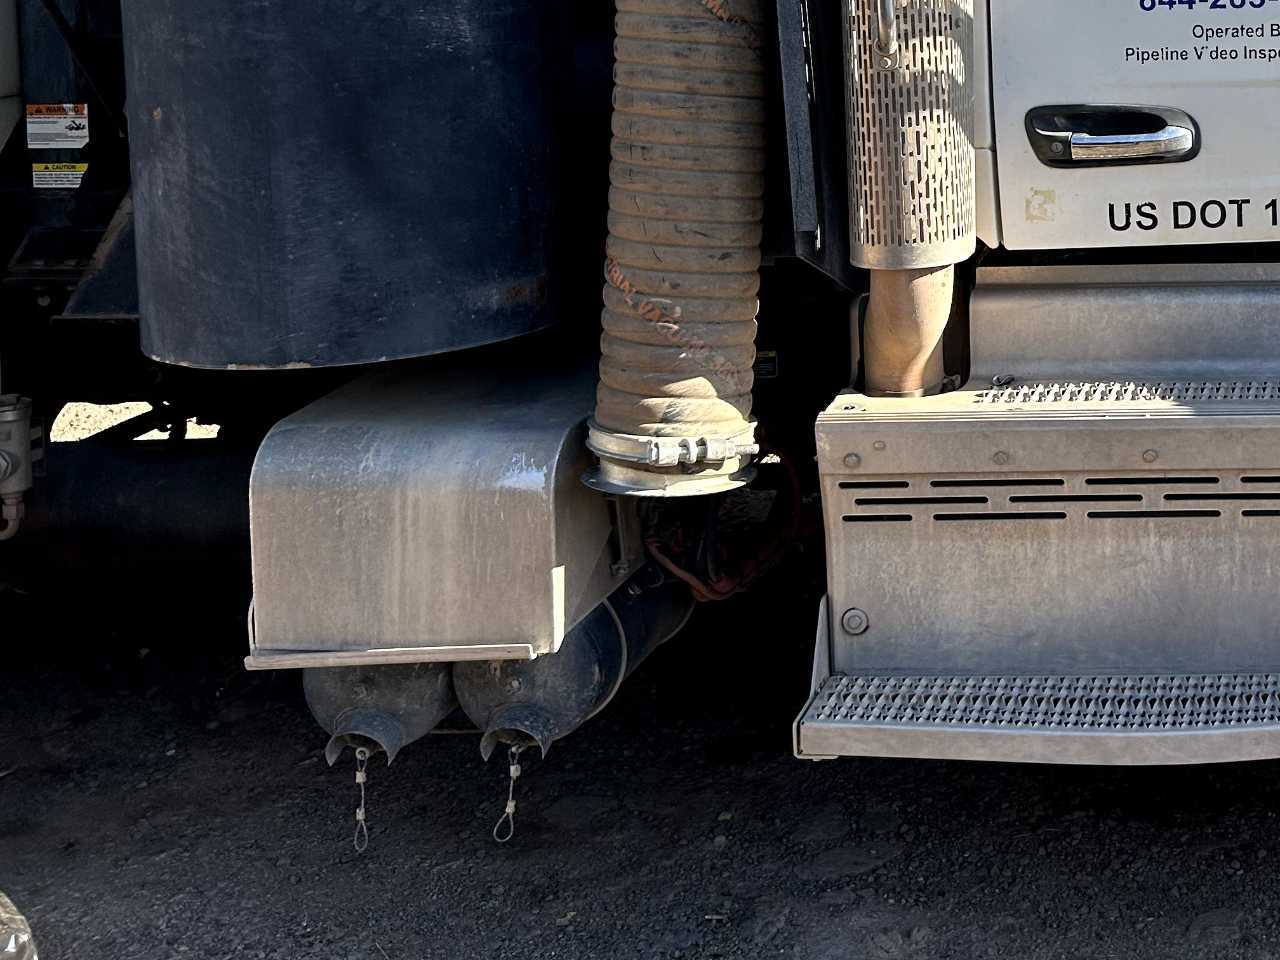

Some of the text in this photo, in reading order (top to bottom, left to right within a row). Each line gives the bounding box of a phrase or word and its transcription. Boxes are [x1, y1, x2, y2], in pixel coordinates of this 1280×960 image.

[1192, 24, 1265, 41] Operated
[1125, 46, 1188, 63] Pipeline
[1194, 45, 1239, 60] Vdeo
[1108, 200, 1158, 231] US
[1172, 198, 1251, 229] DOT
